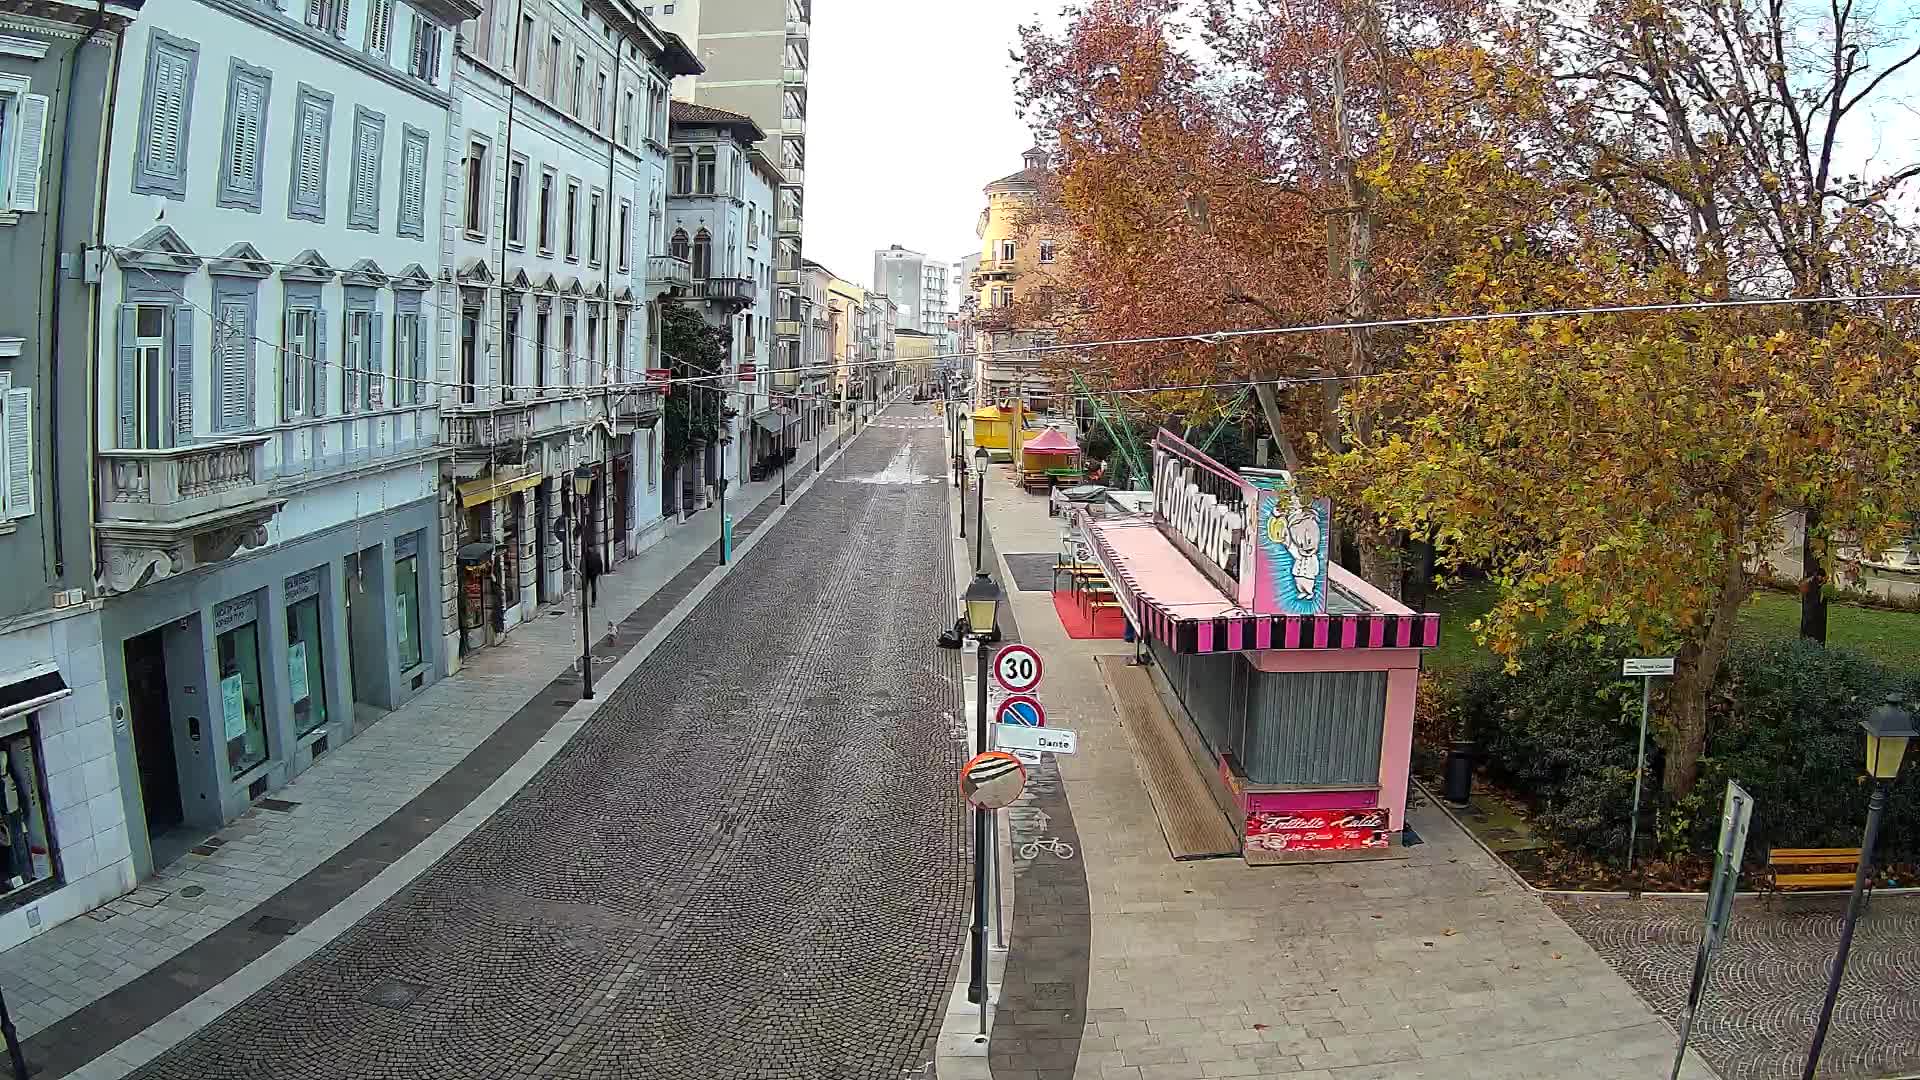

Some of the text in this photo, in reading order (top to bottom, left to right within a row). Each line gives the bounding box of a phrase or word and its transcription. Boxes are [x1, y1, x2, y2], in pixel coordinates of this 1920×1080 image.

[1162, 458, 1240, 570] Golosone
[1005, 658, 1033, 679] 30
[1038, 737, 1069, 749] Dante
